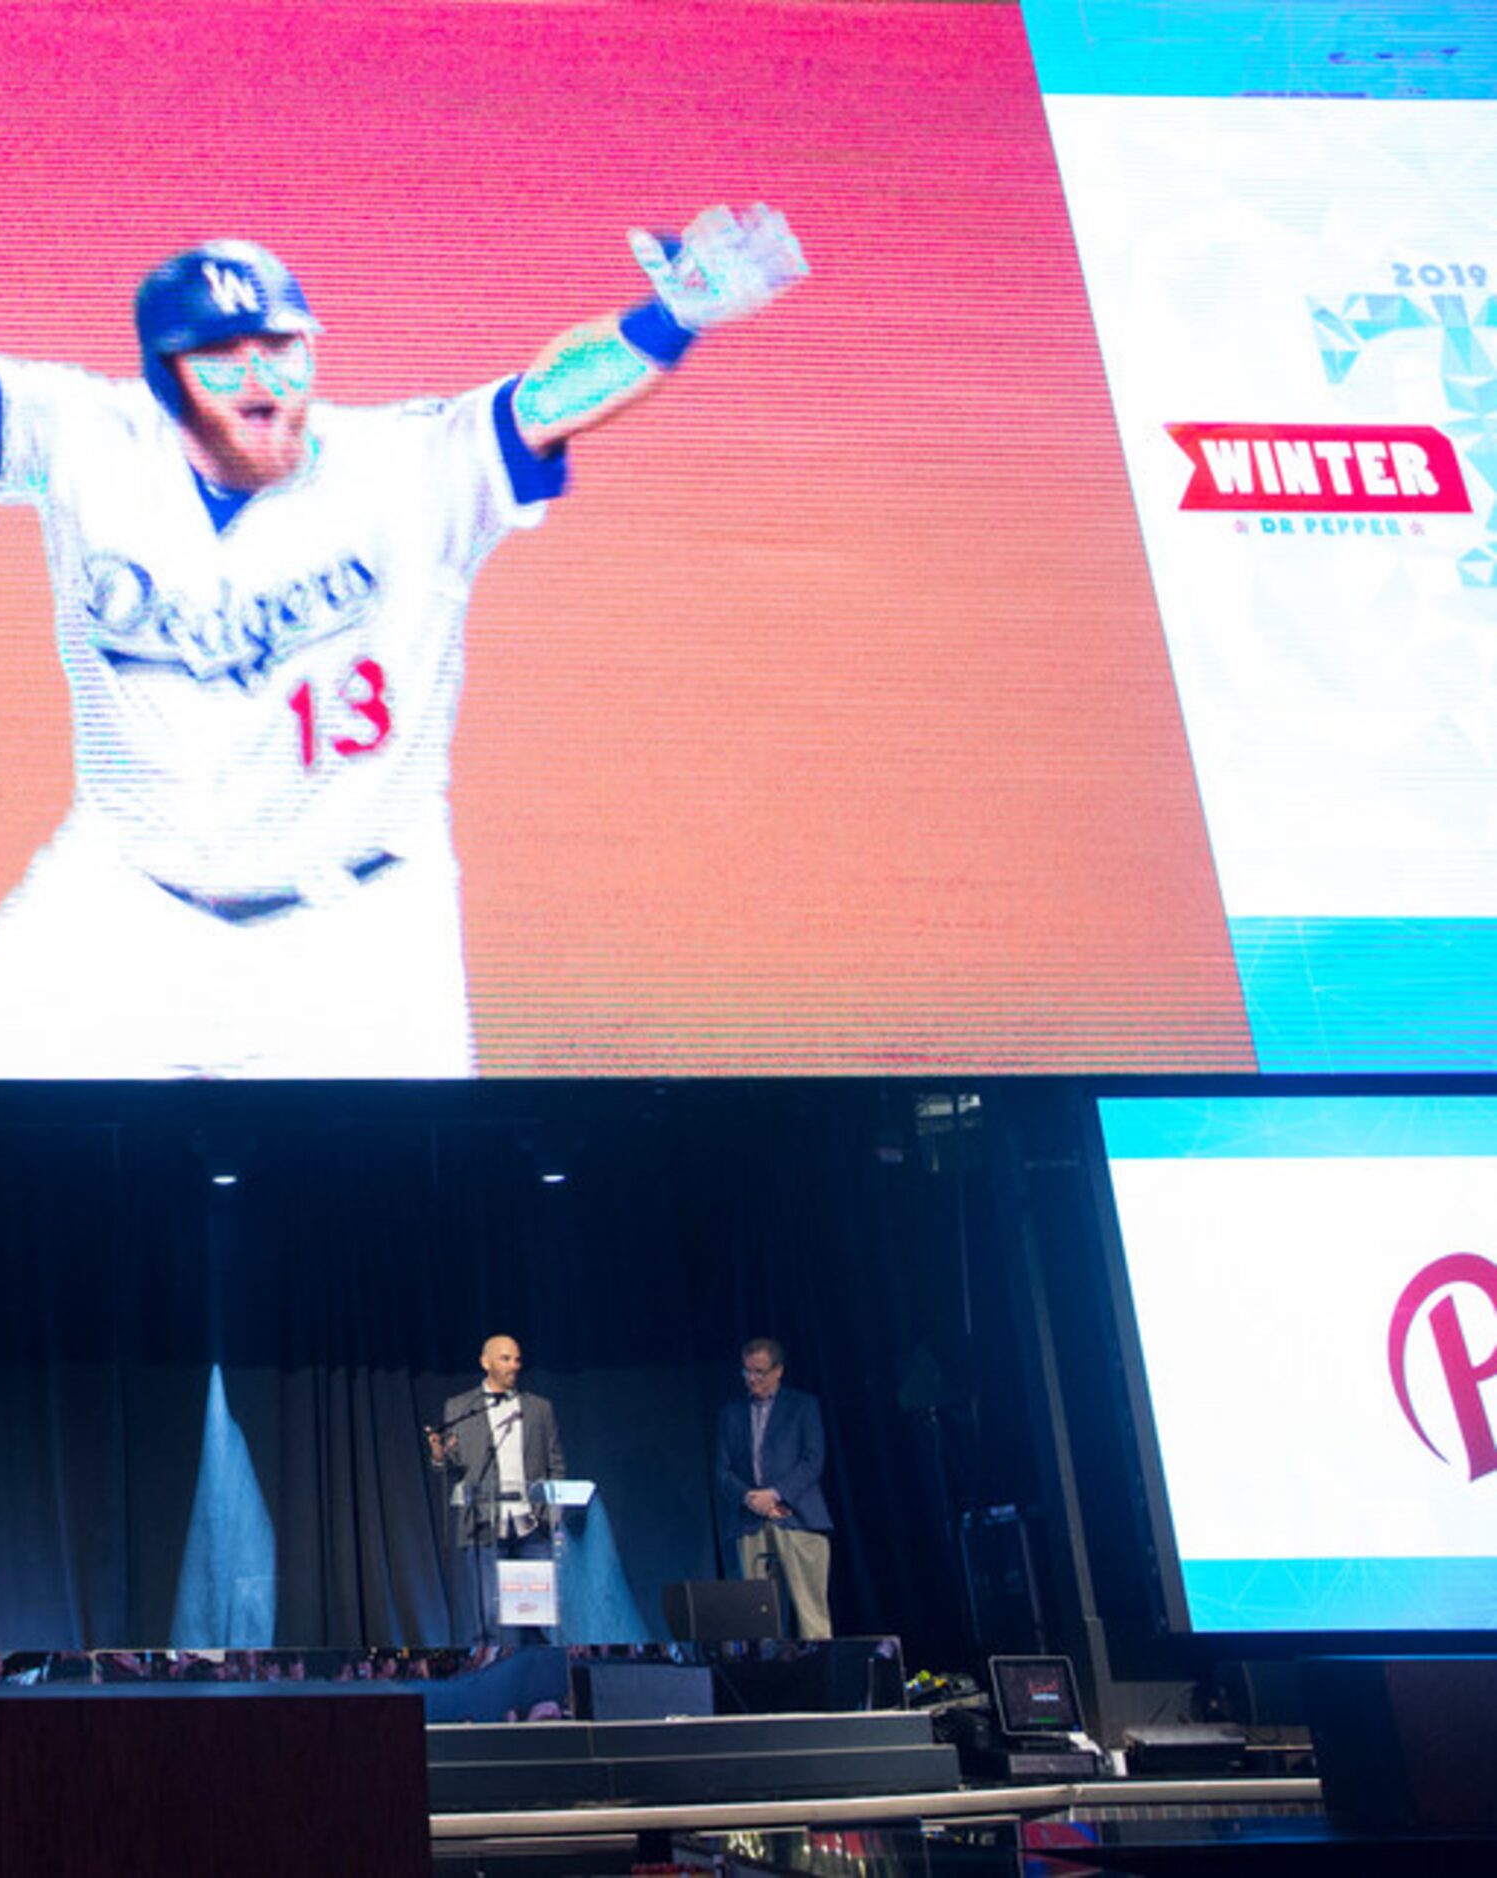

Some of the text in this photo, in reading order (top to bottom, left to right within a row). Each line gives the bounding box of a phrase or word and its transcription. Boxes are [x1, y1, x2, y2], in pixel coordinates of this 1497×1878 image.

[1392, 262, 1487, 287] 2019
[1199, 440, 1440, 496] WINTER
[1259, 517, 1296, 535] DR
[288, 657, 393, 772] 13
